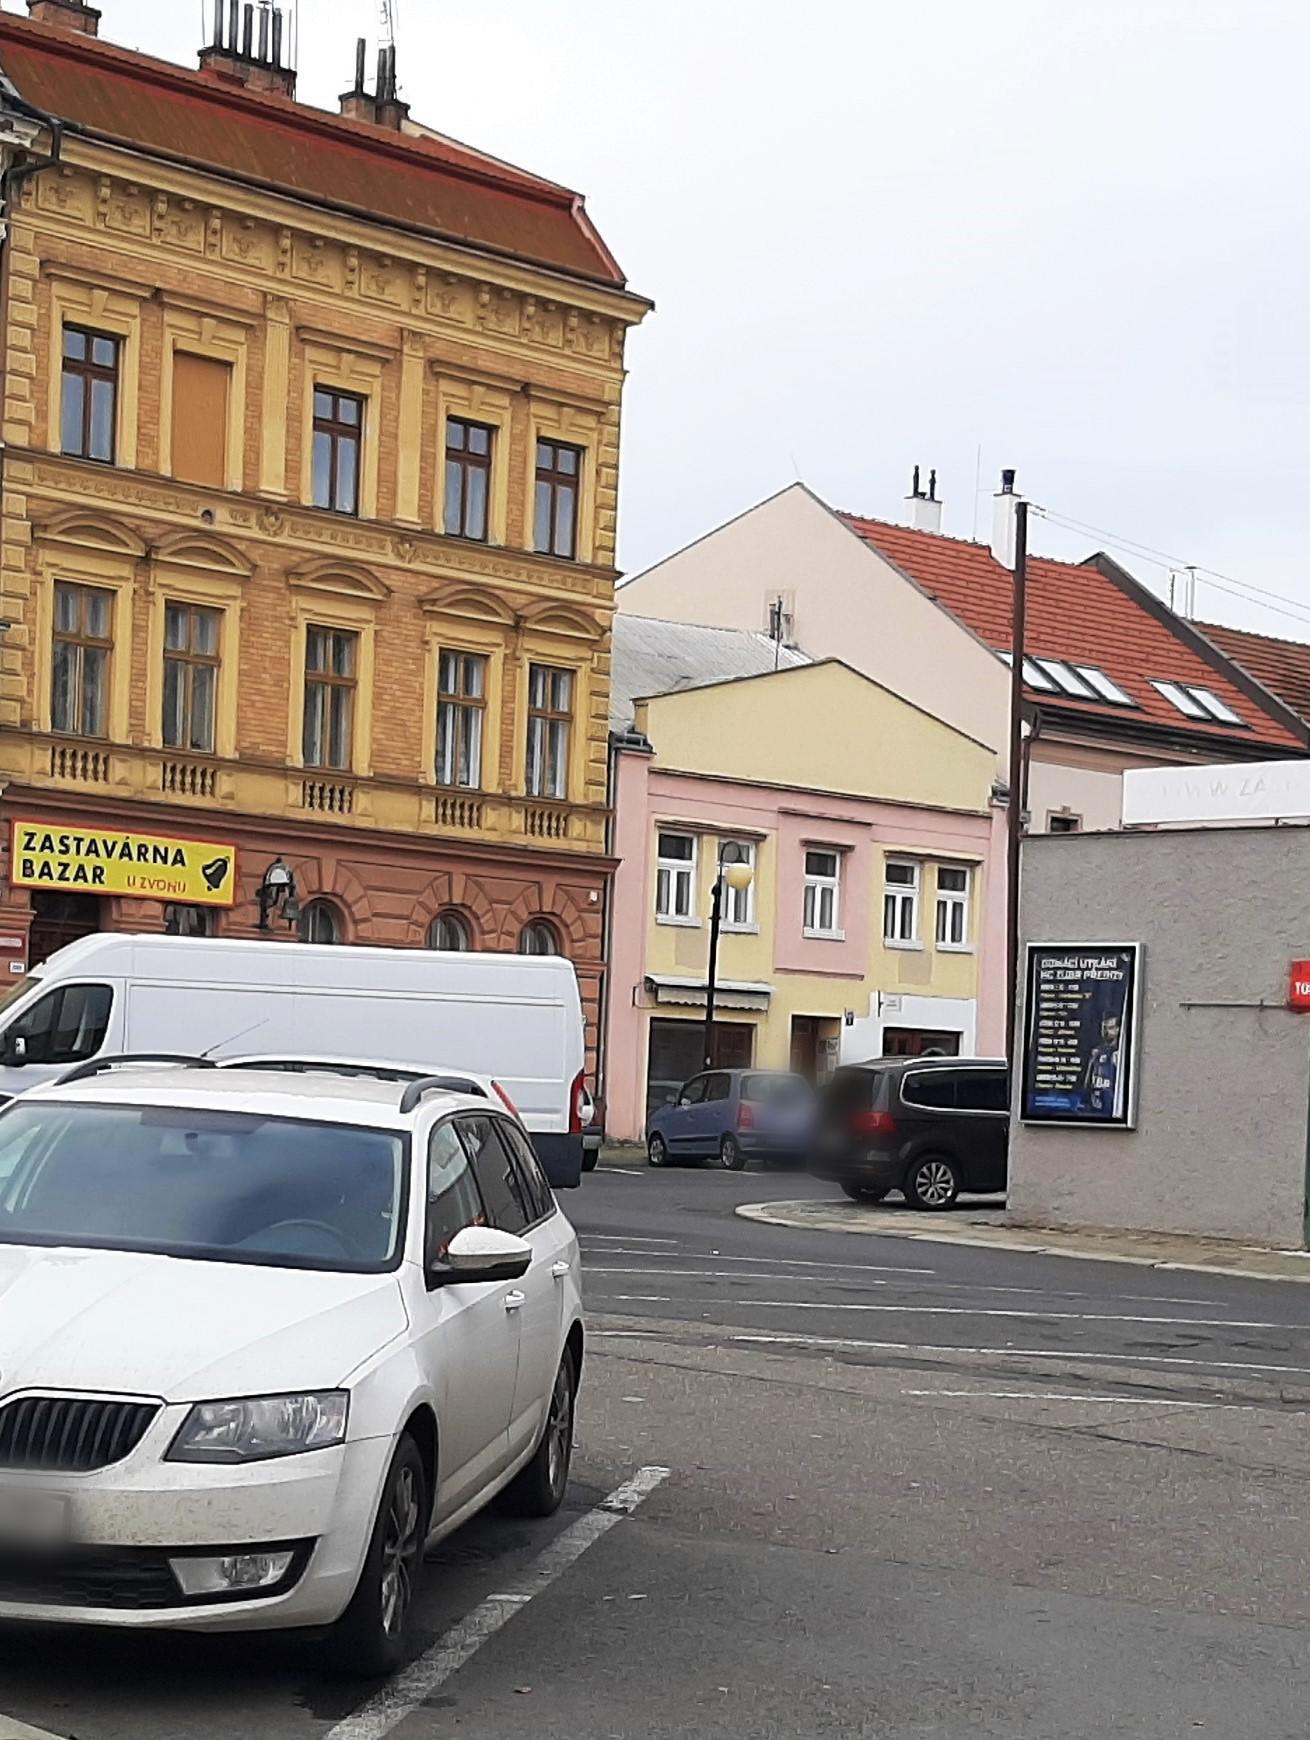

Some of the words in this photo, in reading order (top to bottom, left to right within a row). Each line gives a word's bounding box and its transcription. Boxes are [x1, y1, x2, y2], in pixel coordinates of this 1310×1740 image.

[24, 831, 186, 867] ZASTAVÁRNA
[22, 859, 105, 884] BAZAR
[127, 876, 136, 887] U
[139, 877, 186, 893] ZVONU
